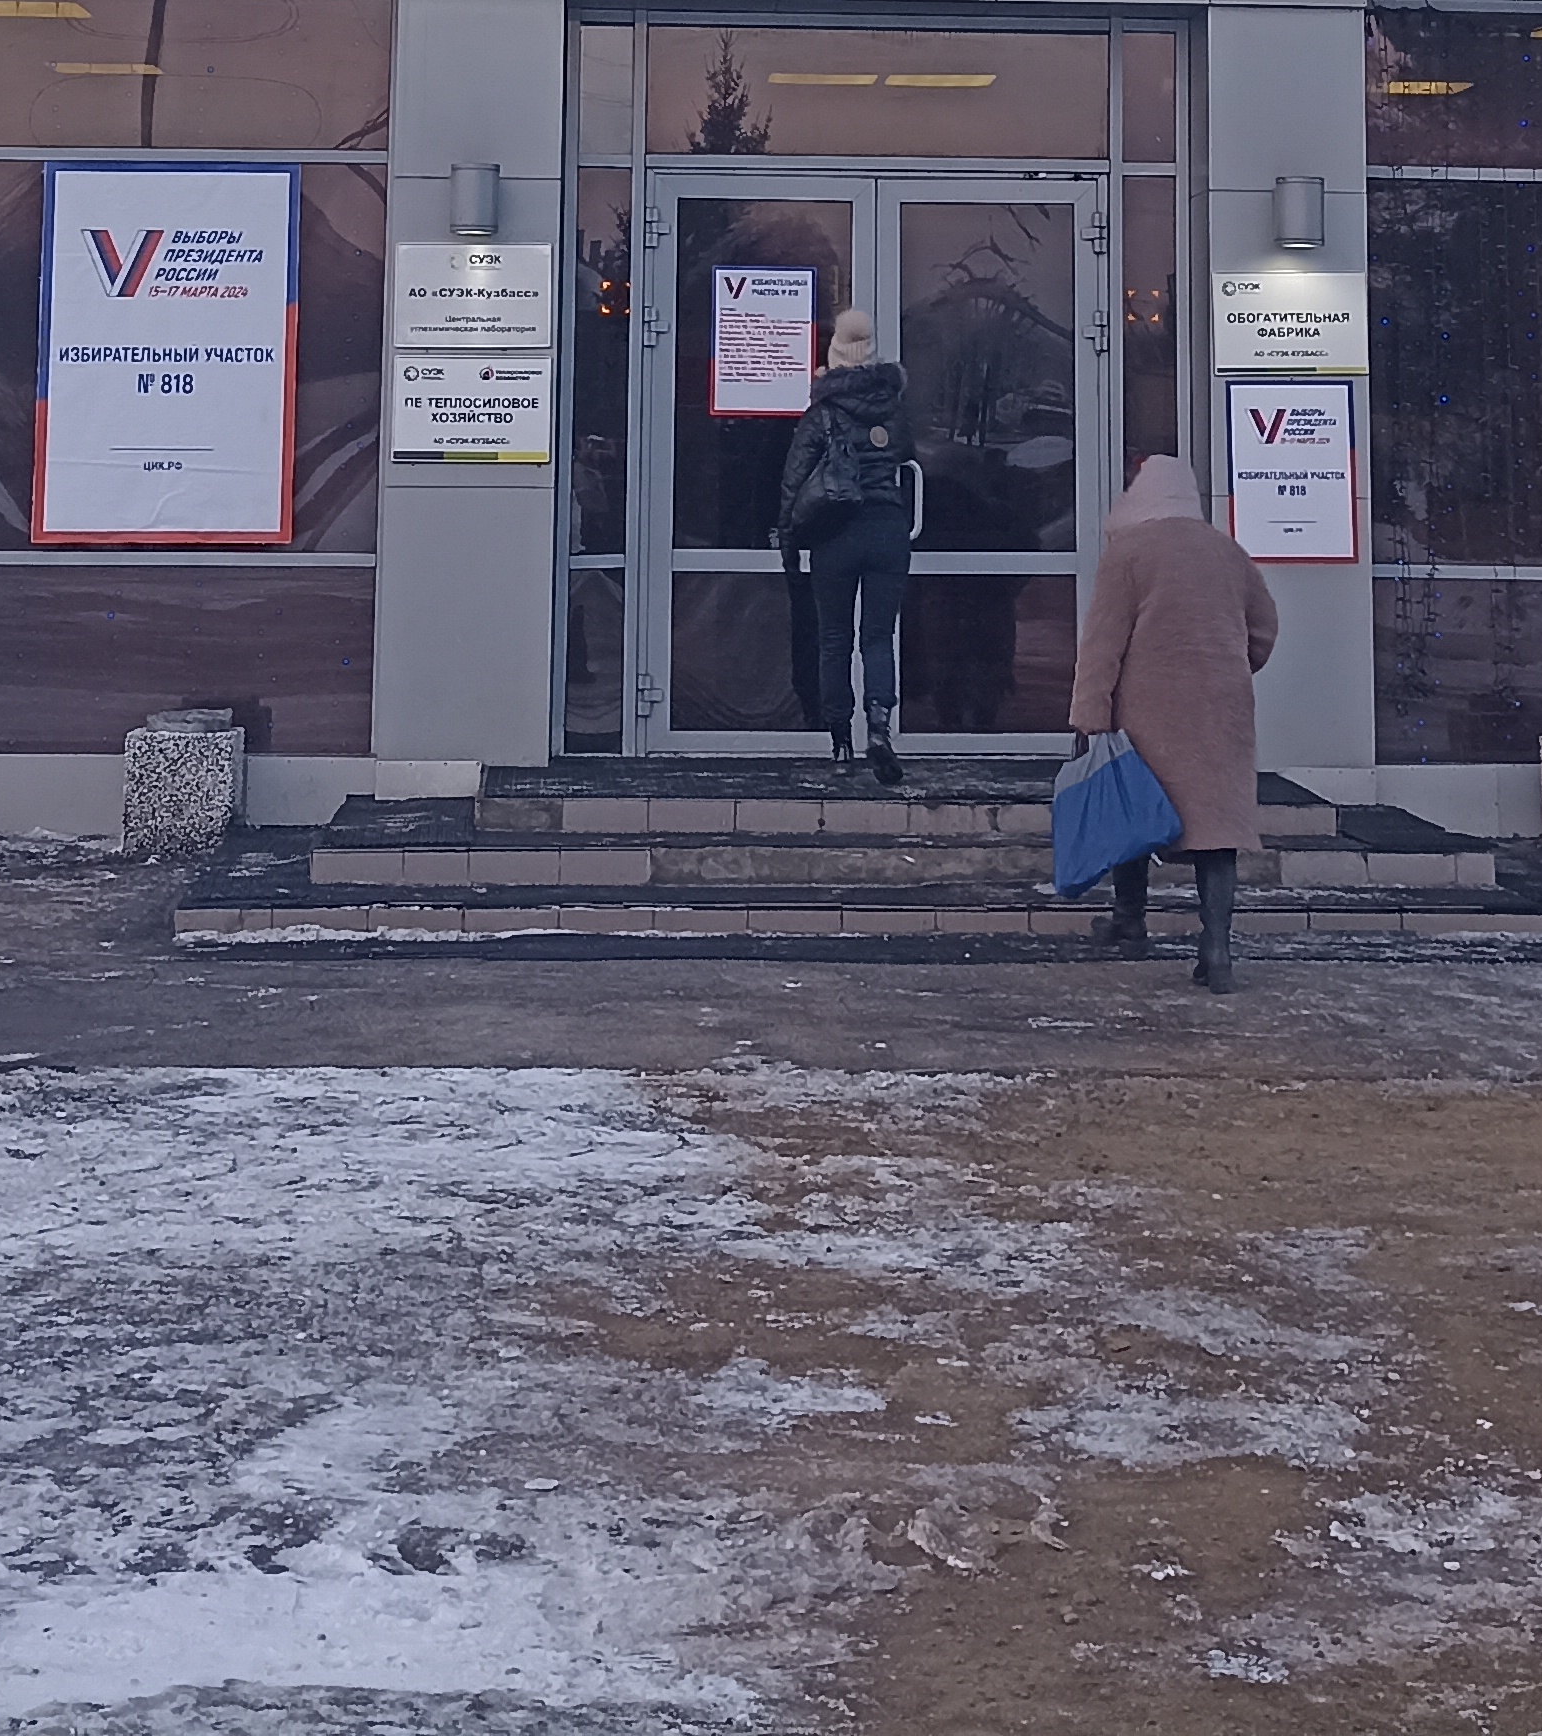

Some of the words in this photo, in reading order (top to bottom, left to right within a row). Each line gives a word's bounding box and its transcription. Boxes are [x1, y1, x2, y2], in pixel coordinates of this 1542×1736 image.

[171, 230, 243, 244] ВЫБОРЫ
[163, 249, 264, 264] ПРЕЗИДЕНТА
[469, 254, 502, 265] СУЭК
[155, 268, 219, 282] РОССИИ
[180, 286, 219, 298] МАРТА
[220, 286, 249, 298] 2024
[408, 288, 427, 298] АО
[431, 288, 539, 299] «СУЭК-Кузбасс»
[445, 315, 502, 324] Центральная
[1227, 312, 1350, 323] ОБОГАТИТЕЛЬНАЯ
[480, 325, 537, 334] лаборатория
[1257, 327, 1321, 337] ФАБРИКА
[59, 344, 200, 363] ИЗБИРАТЕЛЬНЫЙ
[204, 347, 275, 363] УЧАСТОК
[421, 368, 445, 376] СУЭК
[137, 373, 156, 394] №
[160, 373, 195, 394] 818
[404, 397, 422, 408] ПЕ
[427, 397, 539, 409] ТЕПЛОСИЛОВОЕ
[431, 410, 514, 423] ХОЗЯЙСТВО
[1238, 470, 1308, 480] ИЗБИРАТЕЛЬНЫЙ
[1310, 471, 1346, 480] УЧАСТОК
[1289, 485, 1307, 496] 818
